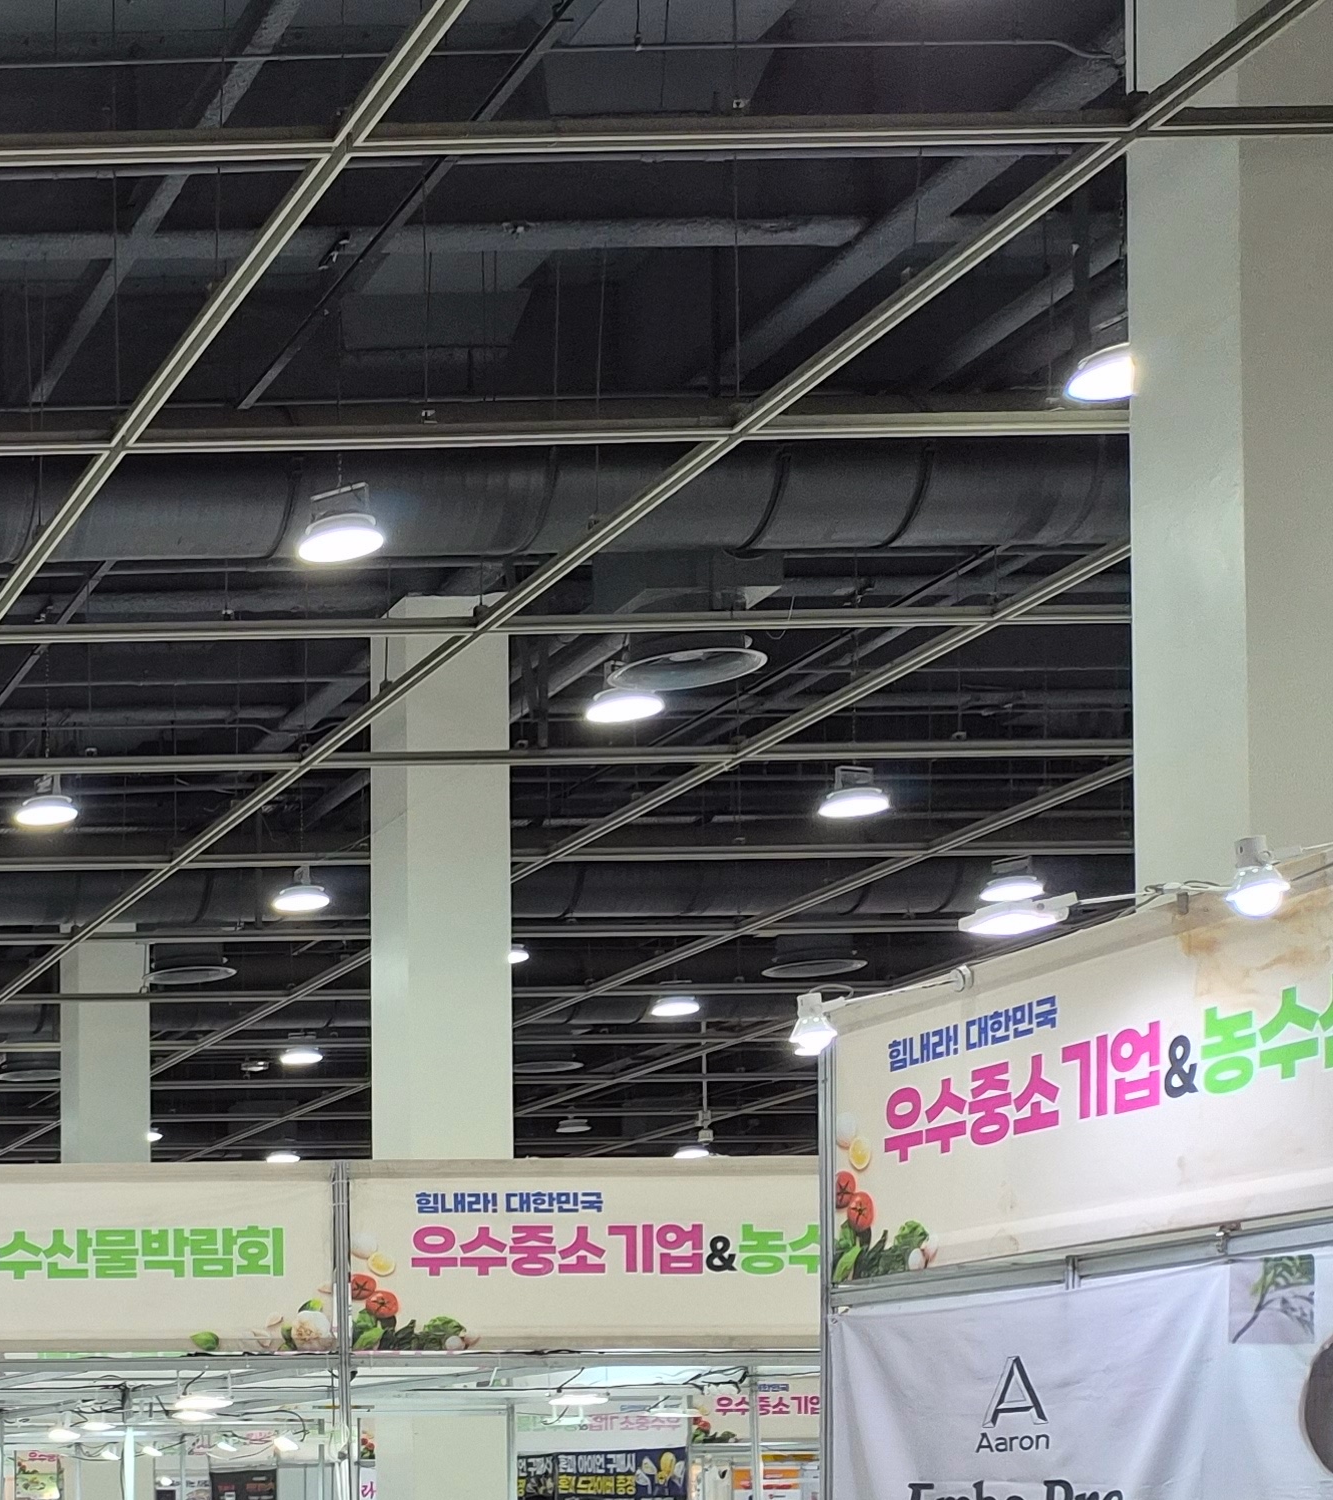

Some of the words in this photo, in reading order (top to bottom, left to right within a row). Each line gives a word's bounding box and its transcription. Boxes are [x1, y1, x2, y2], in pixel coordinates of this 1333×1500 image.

[888, 1025, 958, 1073] 힘내라!
[966, 995, 1057, 1049] 대한민국
[416, 1192, 498, 1214] 힘내라!
[505, 1191, 603, 1214] 대한민국
[975, 1432, 1050, 1453] Aaron
